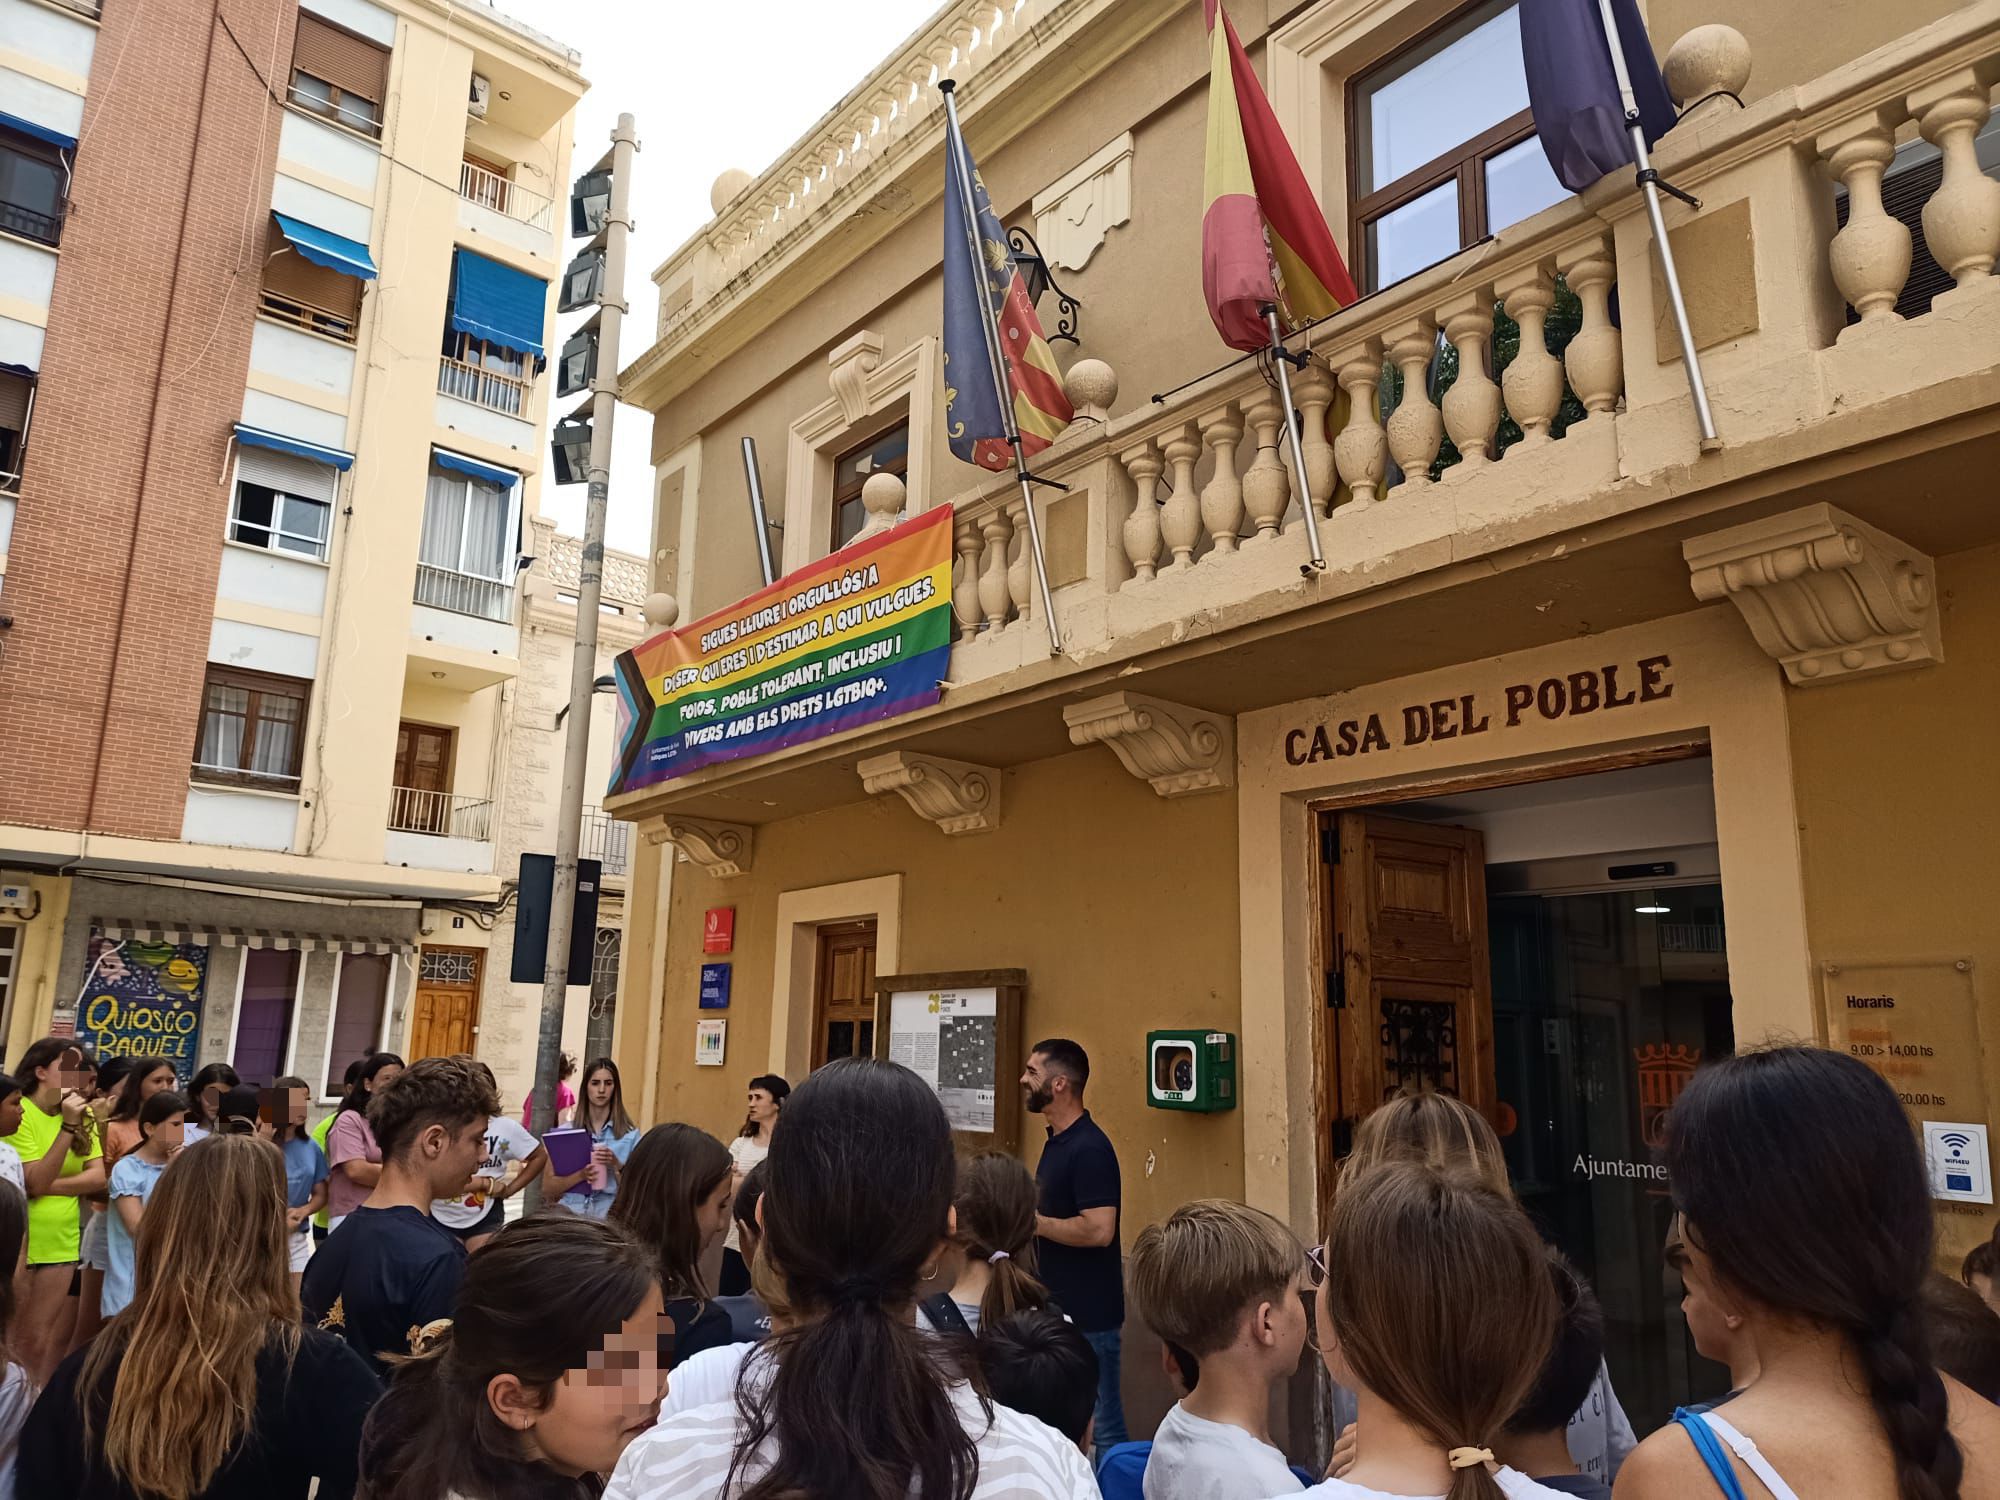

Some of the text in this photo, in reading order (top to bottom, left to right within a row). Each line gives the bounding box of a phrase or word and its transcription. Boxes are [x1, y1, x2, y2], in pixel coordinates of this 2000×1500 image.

[700, 659, 720, 683] QUI
[719, 648, 748, 677] ERES
[748, 645, 755, 665] I
[821, 614, 835, 637] A
[836, 602, 862, 632] QUI
[864, 576, 935, 622] VULGUES.
[701, 563, 879, 654] SIGUES LLIURE I ORGULLÓS/A
[679, 634, 902, 722] FOIOS, POBLE TOLERANT, INCLUSIU I
[684, 677, 888, 749] DIVERS AMB ELS DRETS LGTBIQ+.
[1284, 654, 1674, 766] CASA DEL POBLE
[1846, 995, 1895, 1009] Horaris
[94, 1029, 187, 1061] RAQUEL
[1920, 1045, 1934, 1056] hs
[1573, 1153, 1669, 1181] Ajuntame
